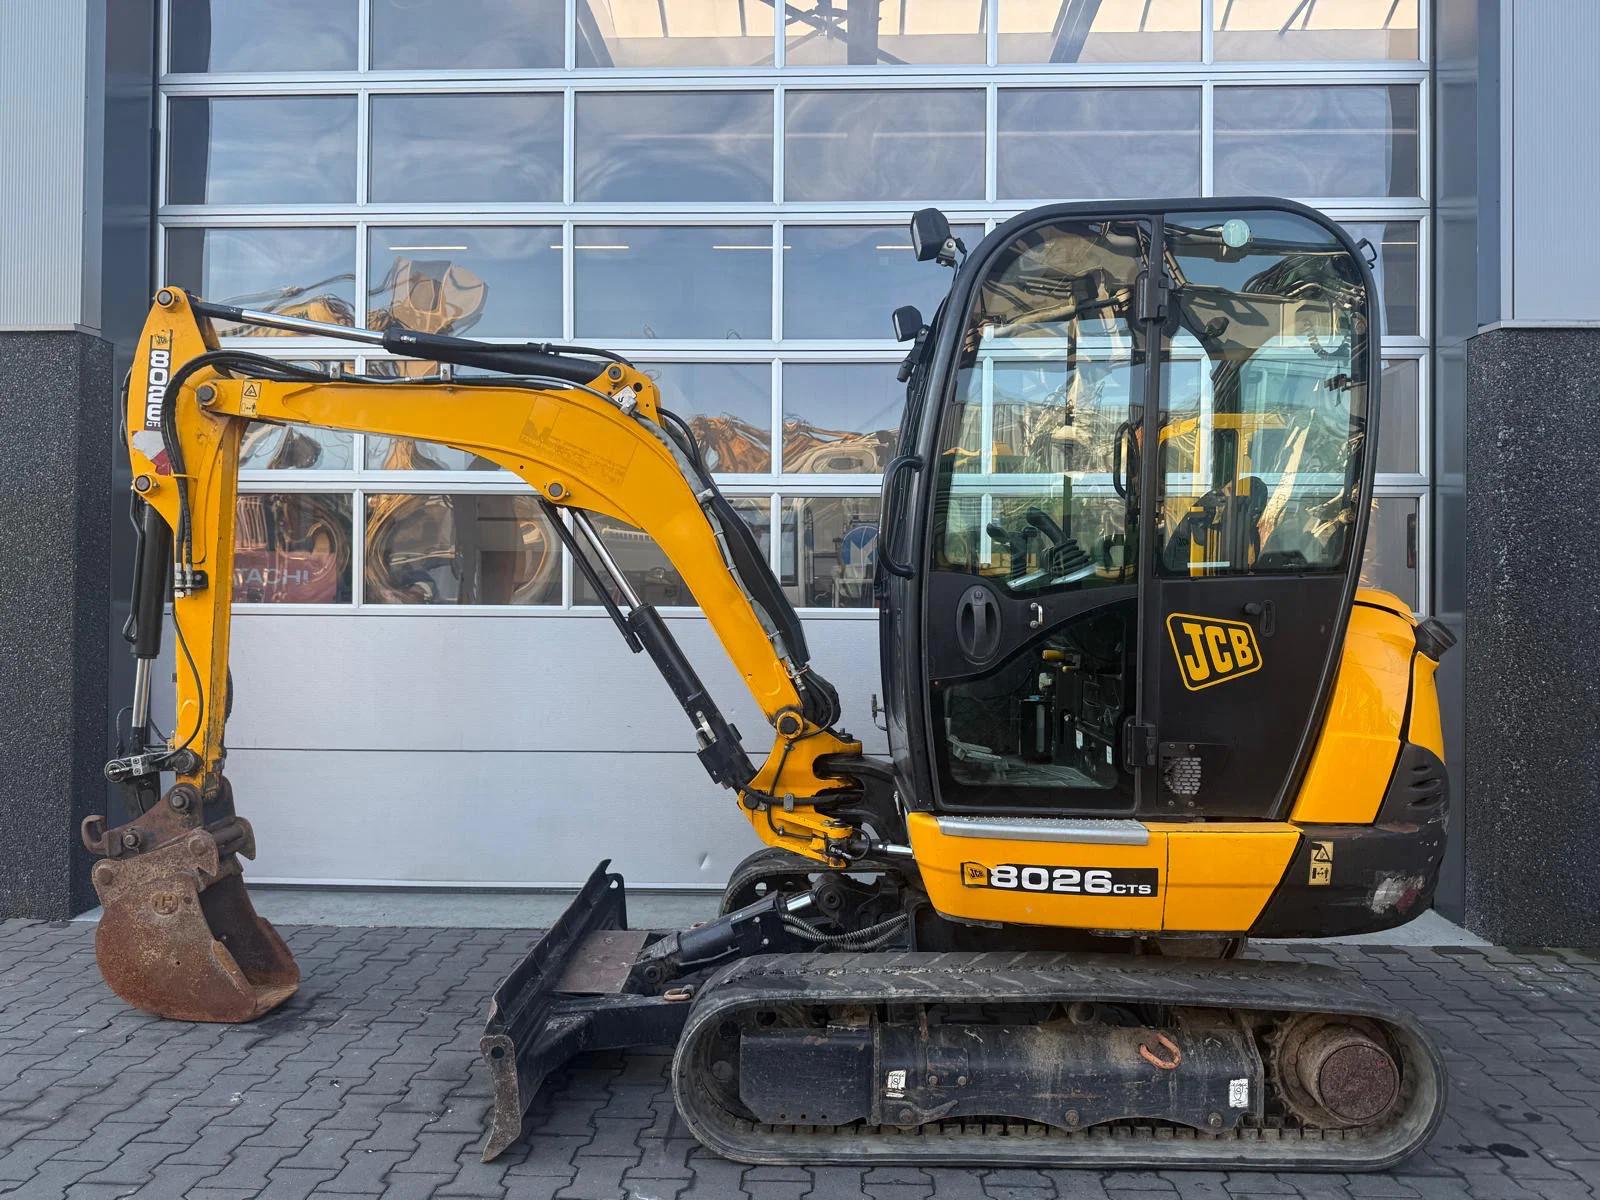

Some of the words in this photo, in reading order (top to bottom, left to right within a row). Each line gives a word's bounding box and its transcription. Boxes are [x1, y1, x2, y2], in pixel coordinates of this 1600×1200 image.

[1182, 622, 1254, 682] JCB
[990, 865, 1112, 893] 8026
[1113, 883, 1152, 895] CTS
